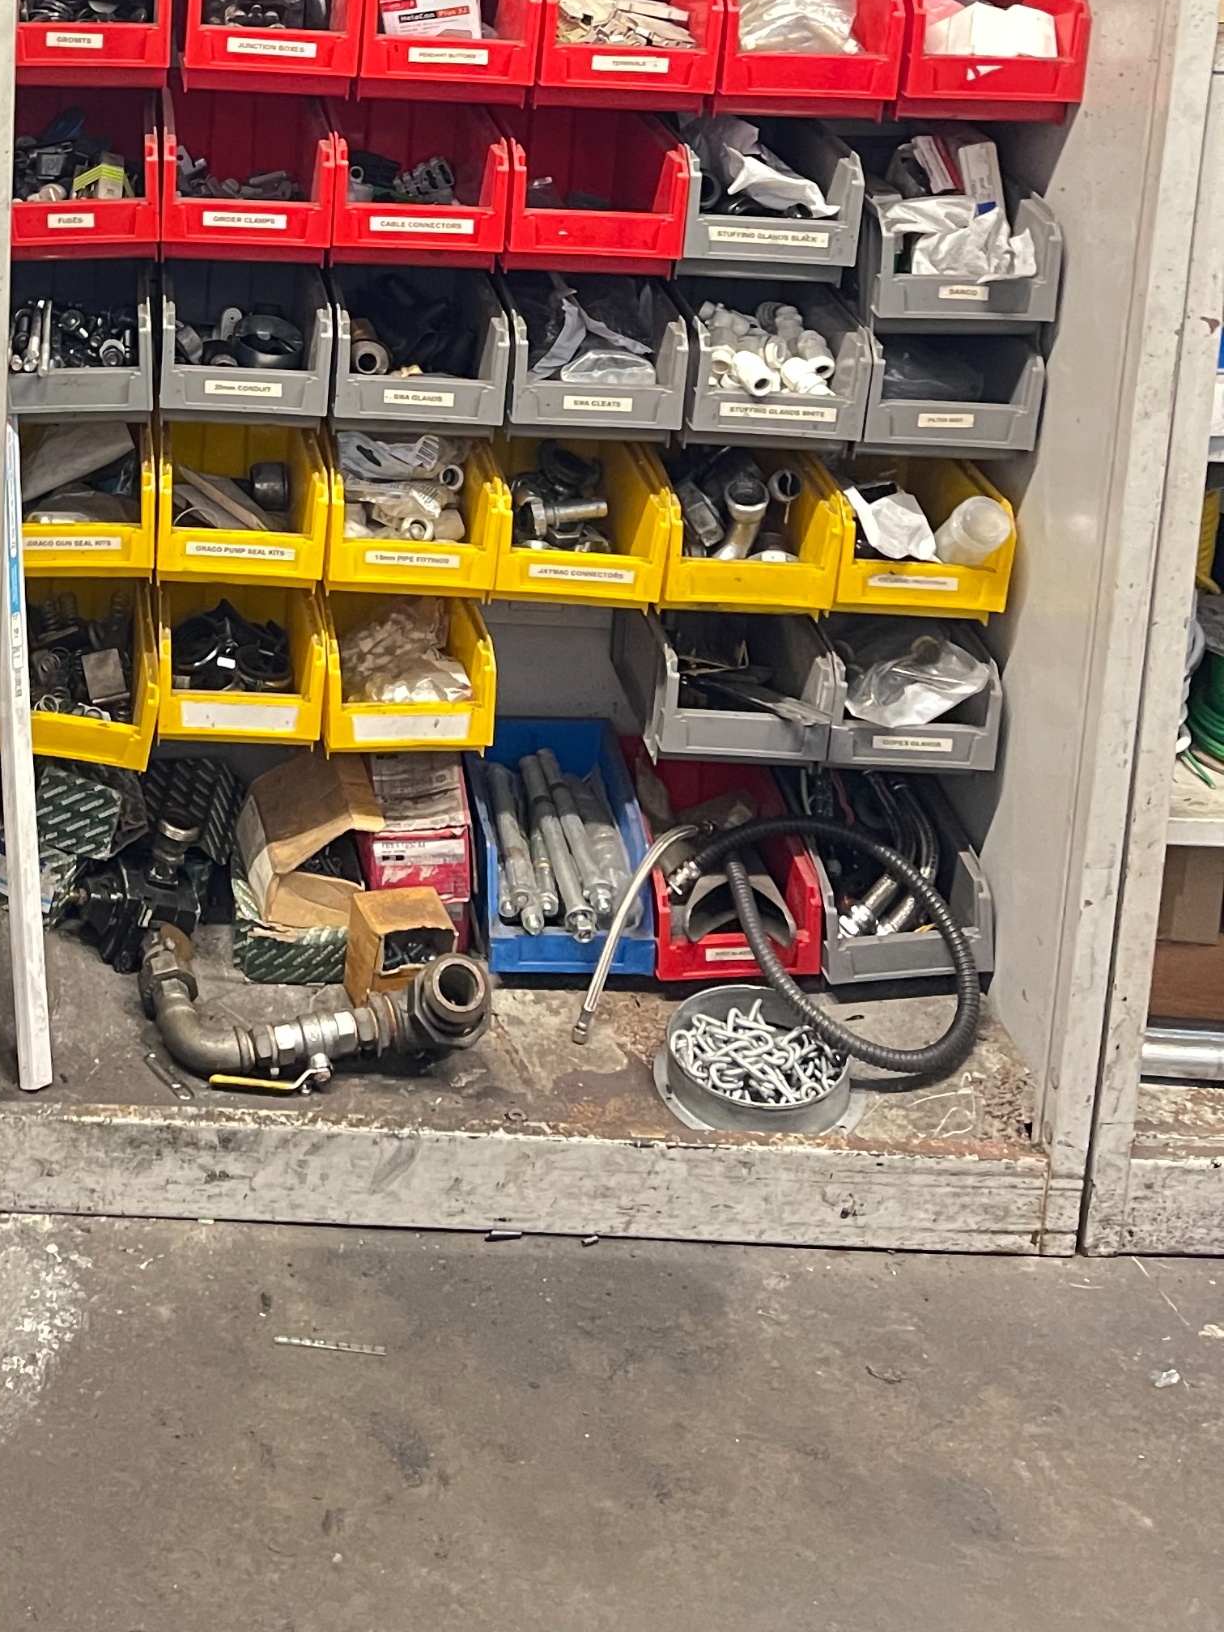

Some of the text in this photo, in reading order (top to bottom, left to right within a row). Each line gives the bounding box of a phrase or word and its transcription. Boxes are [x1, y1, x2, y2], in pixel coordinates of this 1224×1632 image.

[57, 36, 92, 44] GROMITS
[244, 216, 275, 225] CLAMPS
[408, 222, 462, 230] CONNECTORS
[717, 231, 817, 242] STUFFING GLANDS BLACK
[237, 384, 271, 393] CONDUIT
[411, 395, 443, 403] GLANDS
[591, 400, 621, 408] CLEATS
[730, 406, 825, 418] STUFFING GLANDS WHITE
[416, 556, 449, 564] FITTINGS
[571, 570, 624, 579] CONNECTORS
